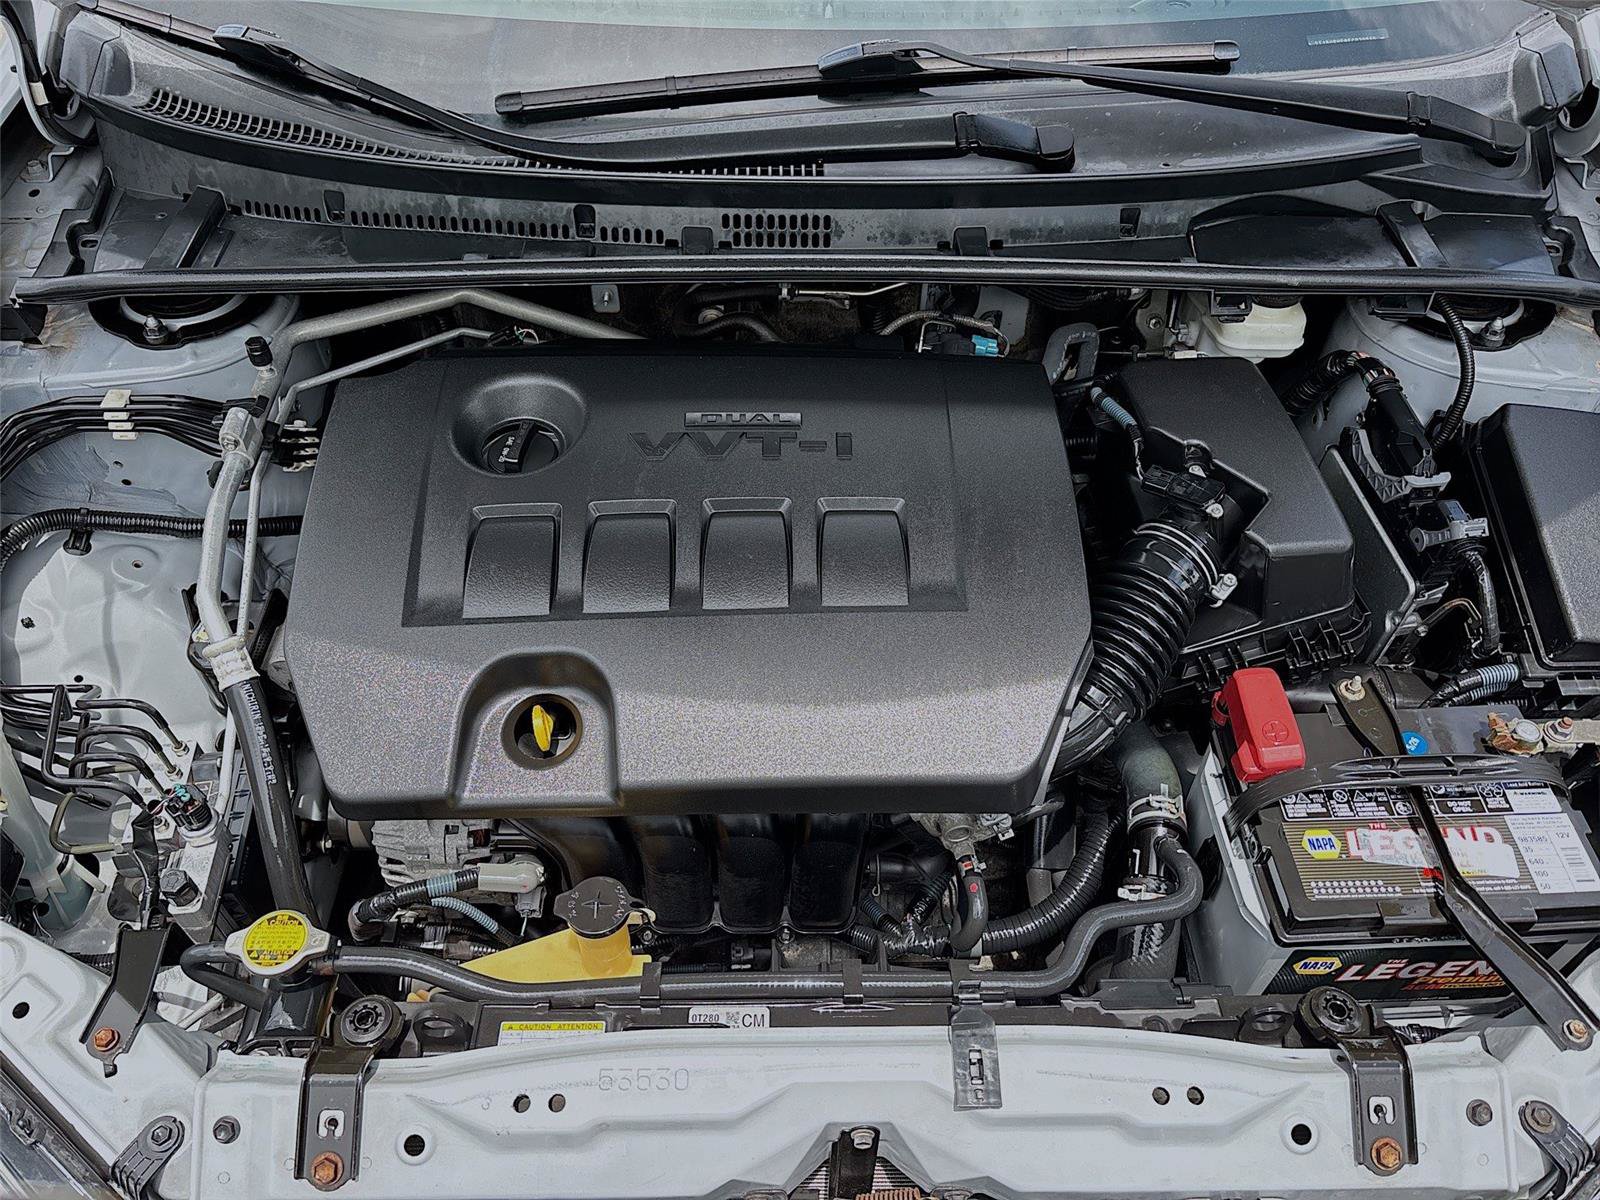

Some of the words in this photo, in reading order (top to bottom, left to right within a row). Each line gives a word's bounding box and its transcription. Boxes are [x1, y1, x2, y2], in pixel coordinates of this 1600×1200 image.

[701, 413, 793, 423] DUAL
[242, 682, 262, 720] NICHIRIN
[1307, 837, 1337, 851] NAPA
[1298, 960, 1336, 971] NAPA
[519, 1023, 552, 1031] CAUTION
[557, 1023, 598, 1031] ATTENTION
[742, 1013, 765, 1028] CM
[598, 1068, 689, 1092] 53530
